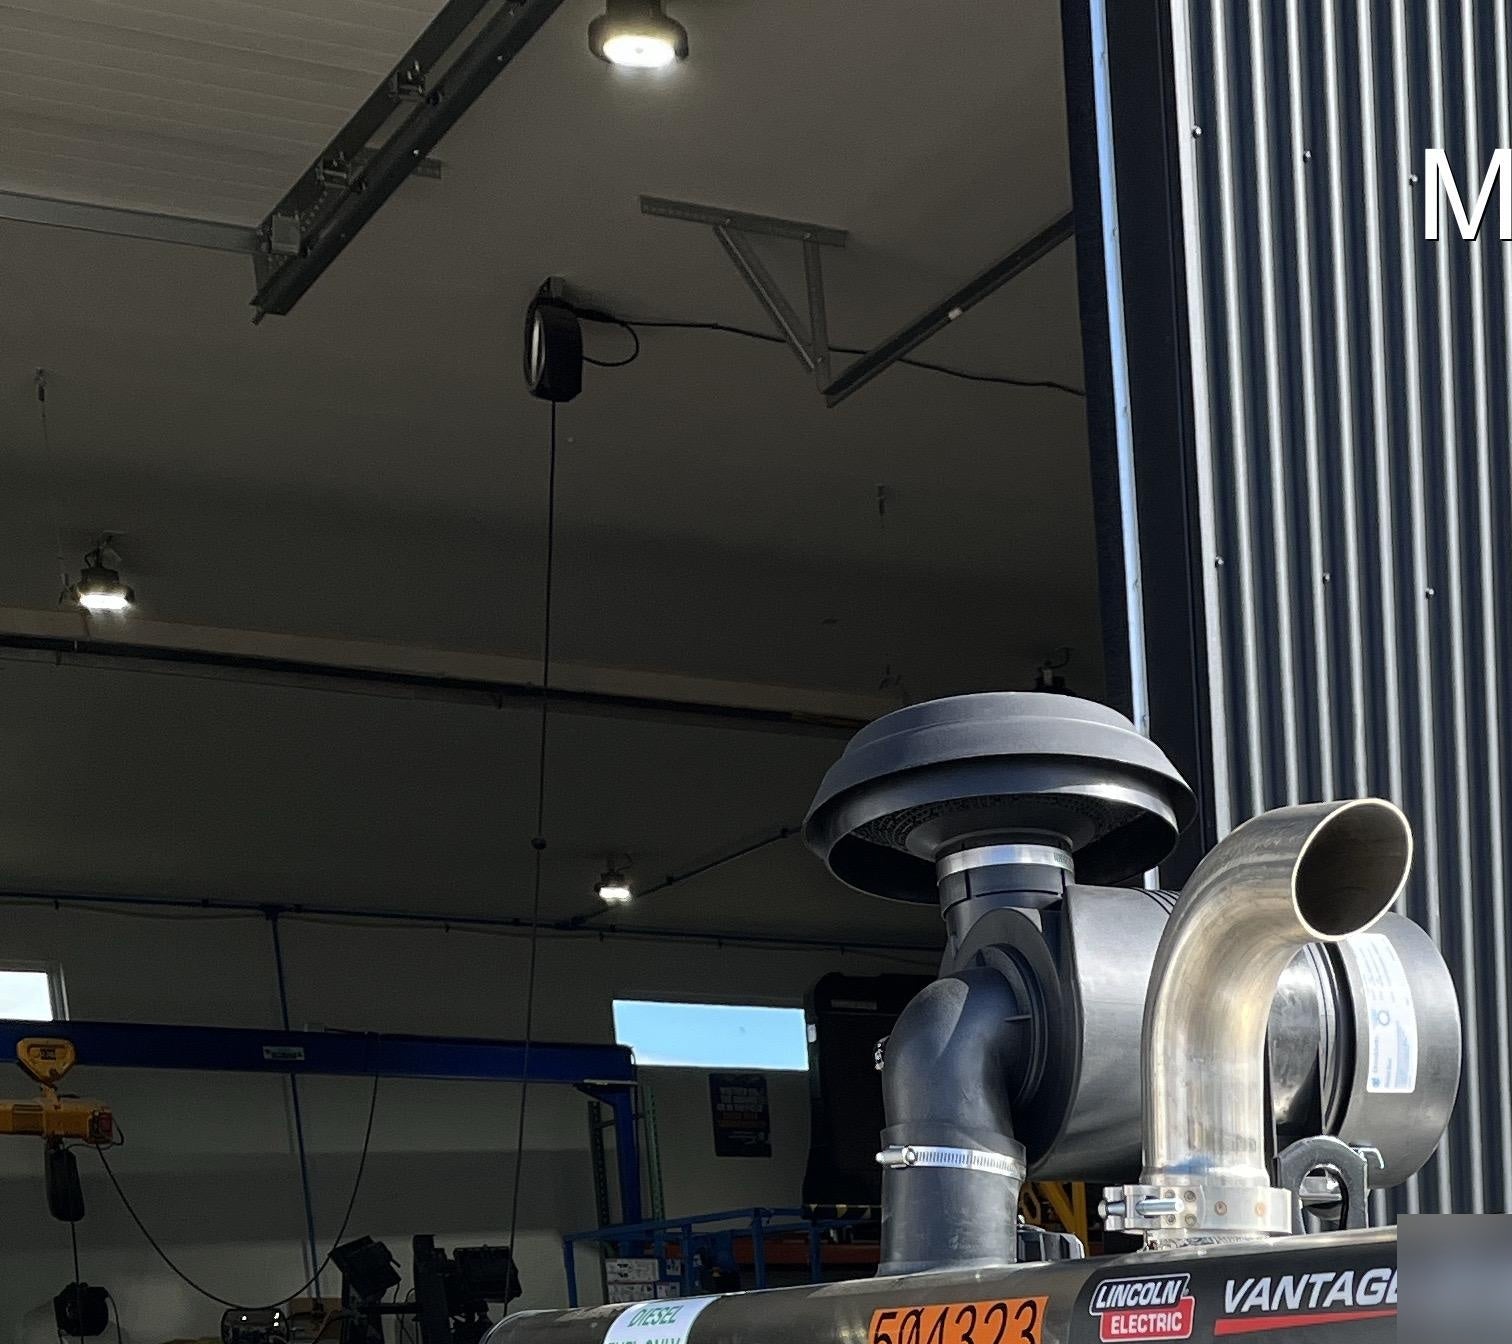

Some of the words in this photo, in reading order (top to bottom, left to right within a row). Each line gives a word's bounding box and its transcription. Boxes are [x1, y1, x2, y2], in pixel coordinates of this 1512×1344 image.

[1095, 1279, 1182, 1309] LINCOLN
[627, 1305, 685, 1328] DIESEL
[1110, 1311, 1182, 1335] ELECTRIC
